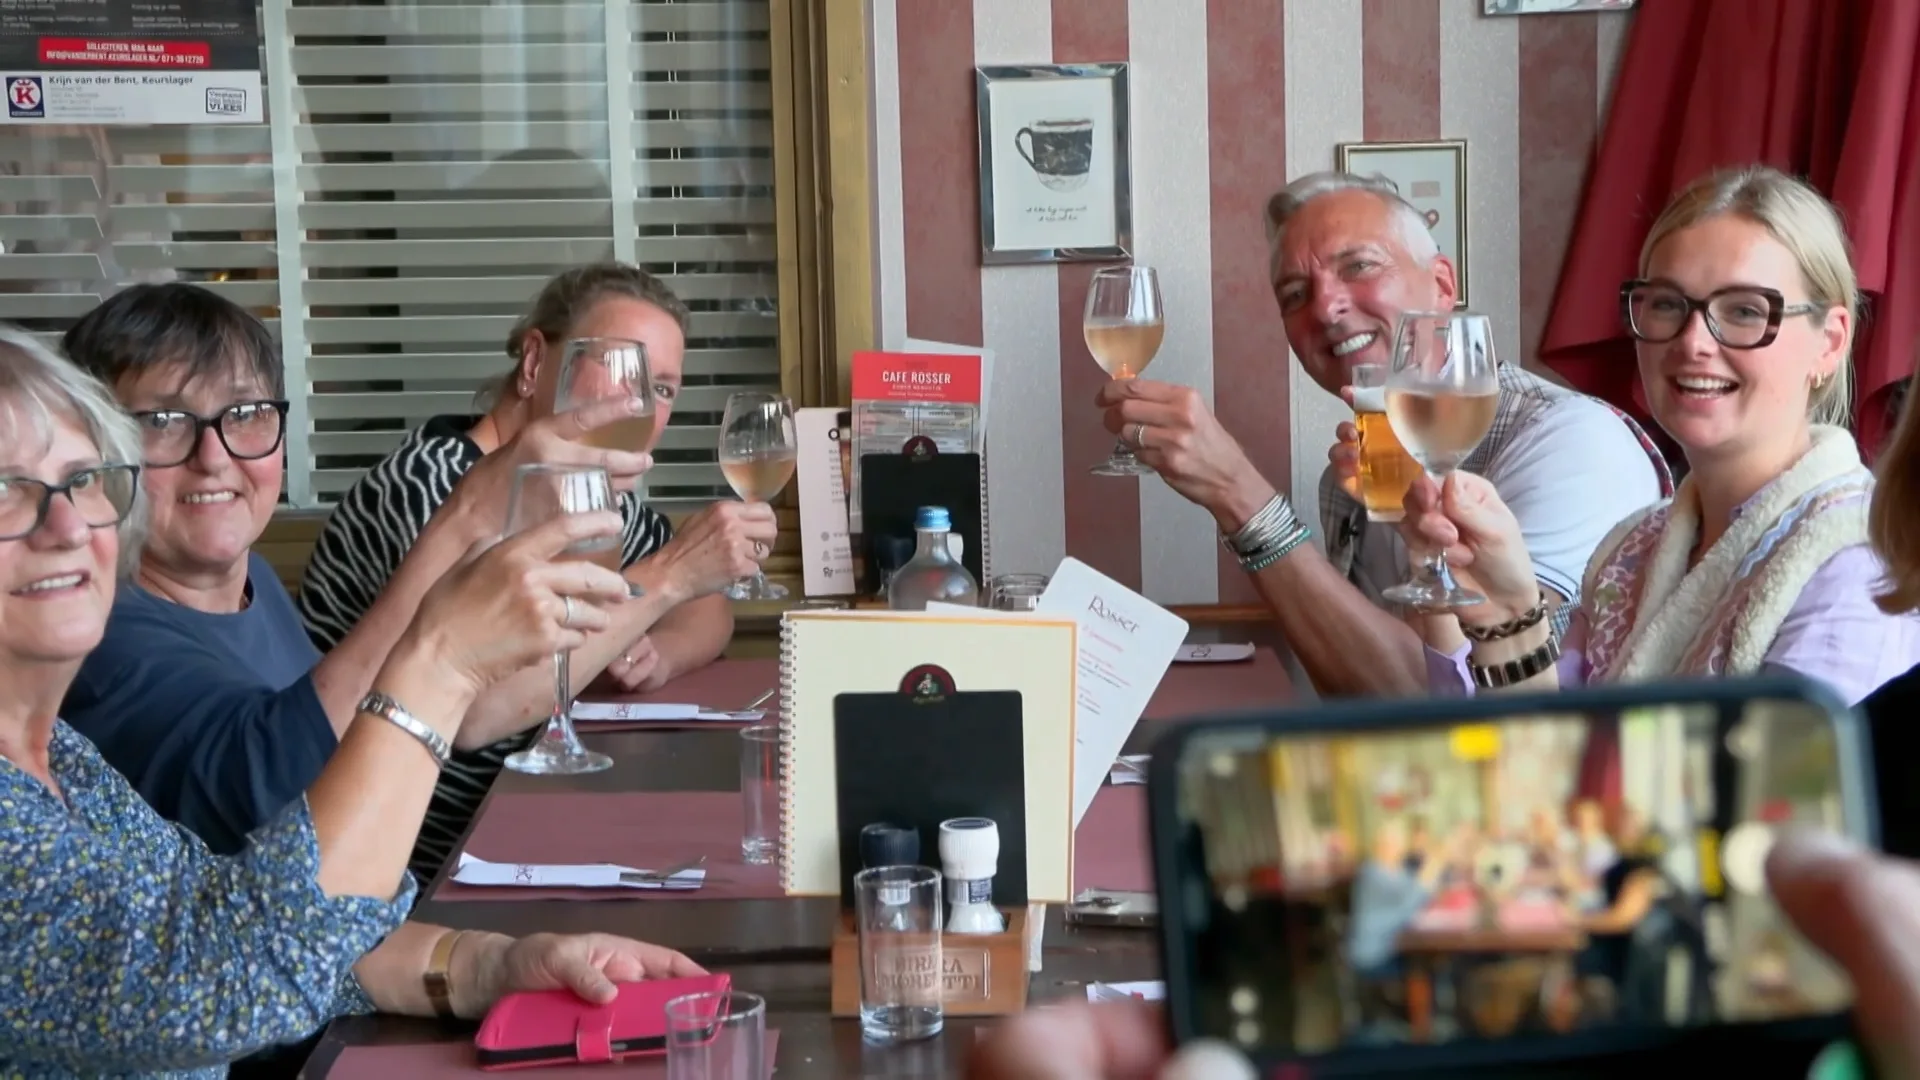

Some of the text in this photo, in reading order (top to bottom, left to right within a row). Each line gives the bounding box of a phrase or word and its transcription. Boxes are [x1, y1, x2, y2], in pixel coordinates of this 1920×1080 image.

[49, 76, 71, 86] Krijn
[95, 76, 111, 84] der
[142, 76, 193, 86] Keurslager
[15, 87, 35, 105] K
[883, 371, 951, 384] CAFE ROSSER
